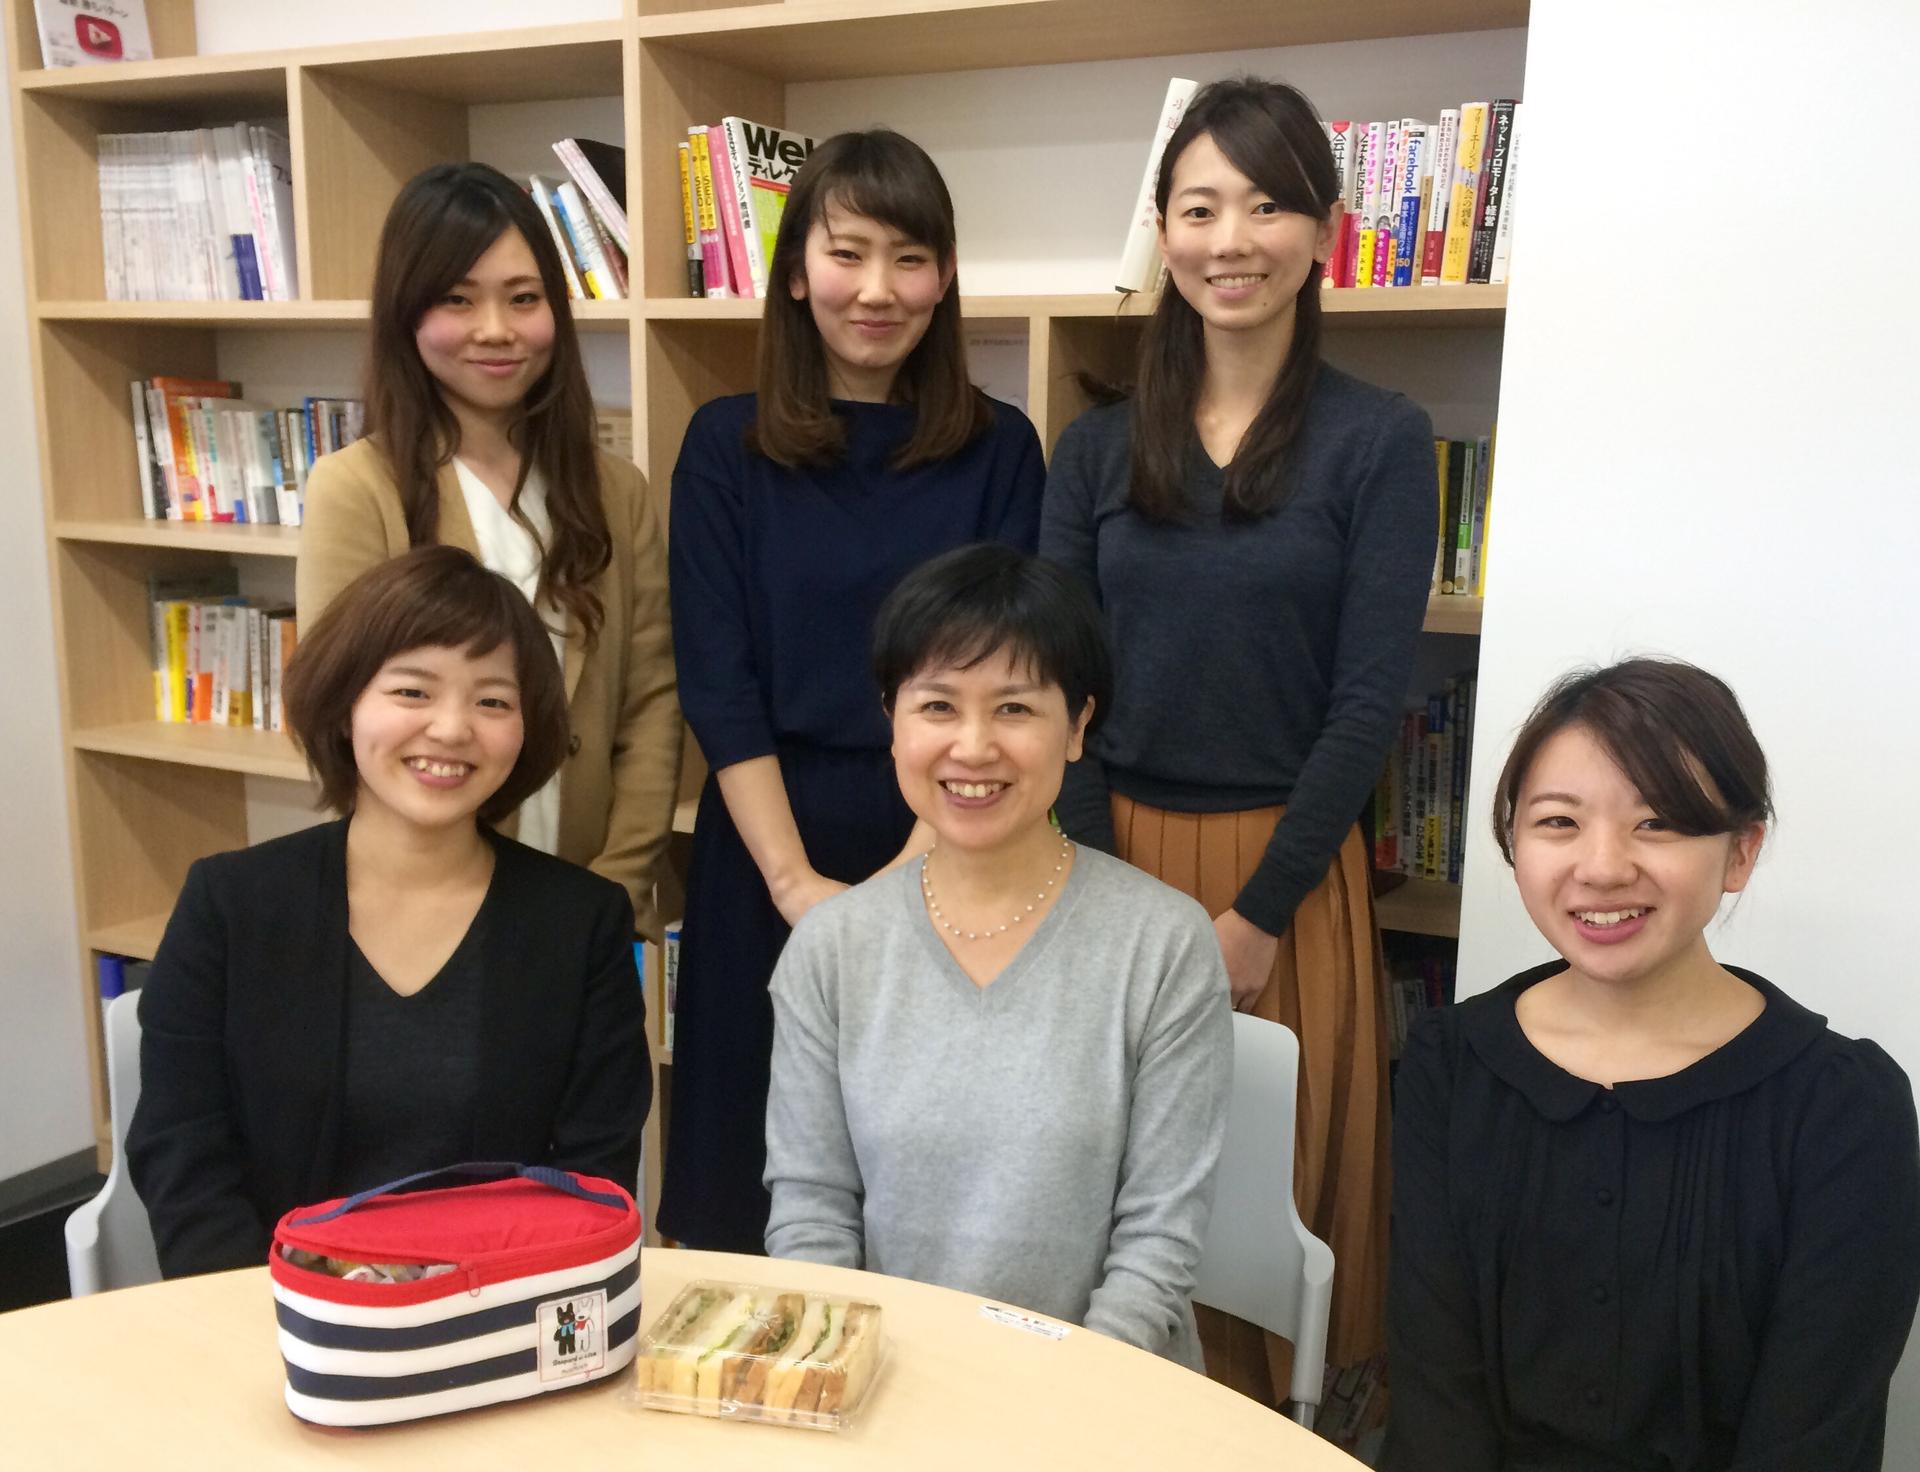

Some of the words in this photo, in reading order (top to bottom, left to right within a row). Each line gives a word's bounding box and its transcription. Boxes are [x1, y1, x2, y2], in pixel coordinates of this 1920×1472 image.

[1404, 139, 1421, 194] facebook
[1484, 114, 1510, 227] ネット・プロモーター経営
